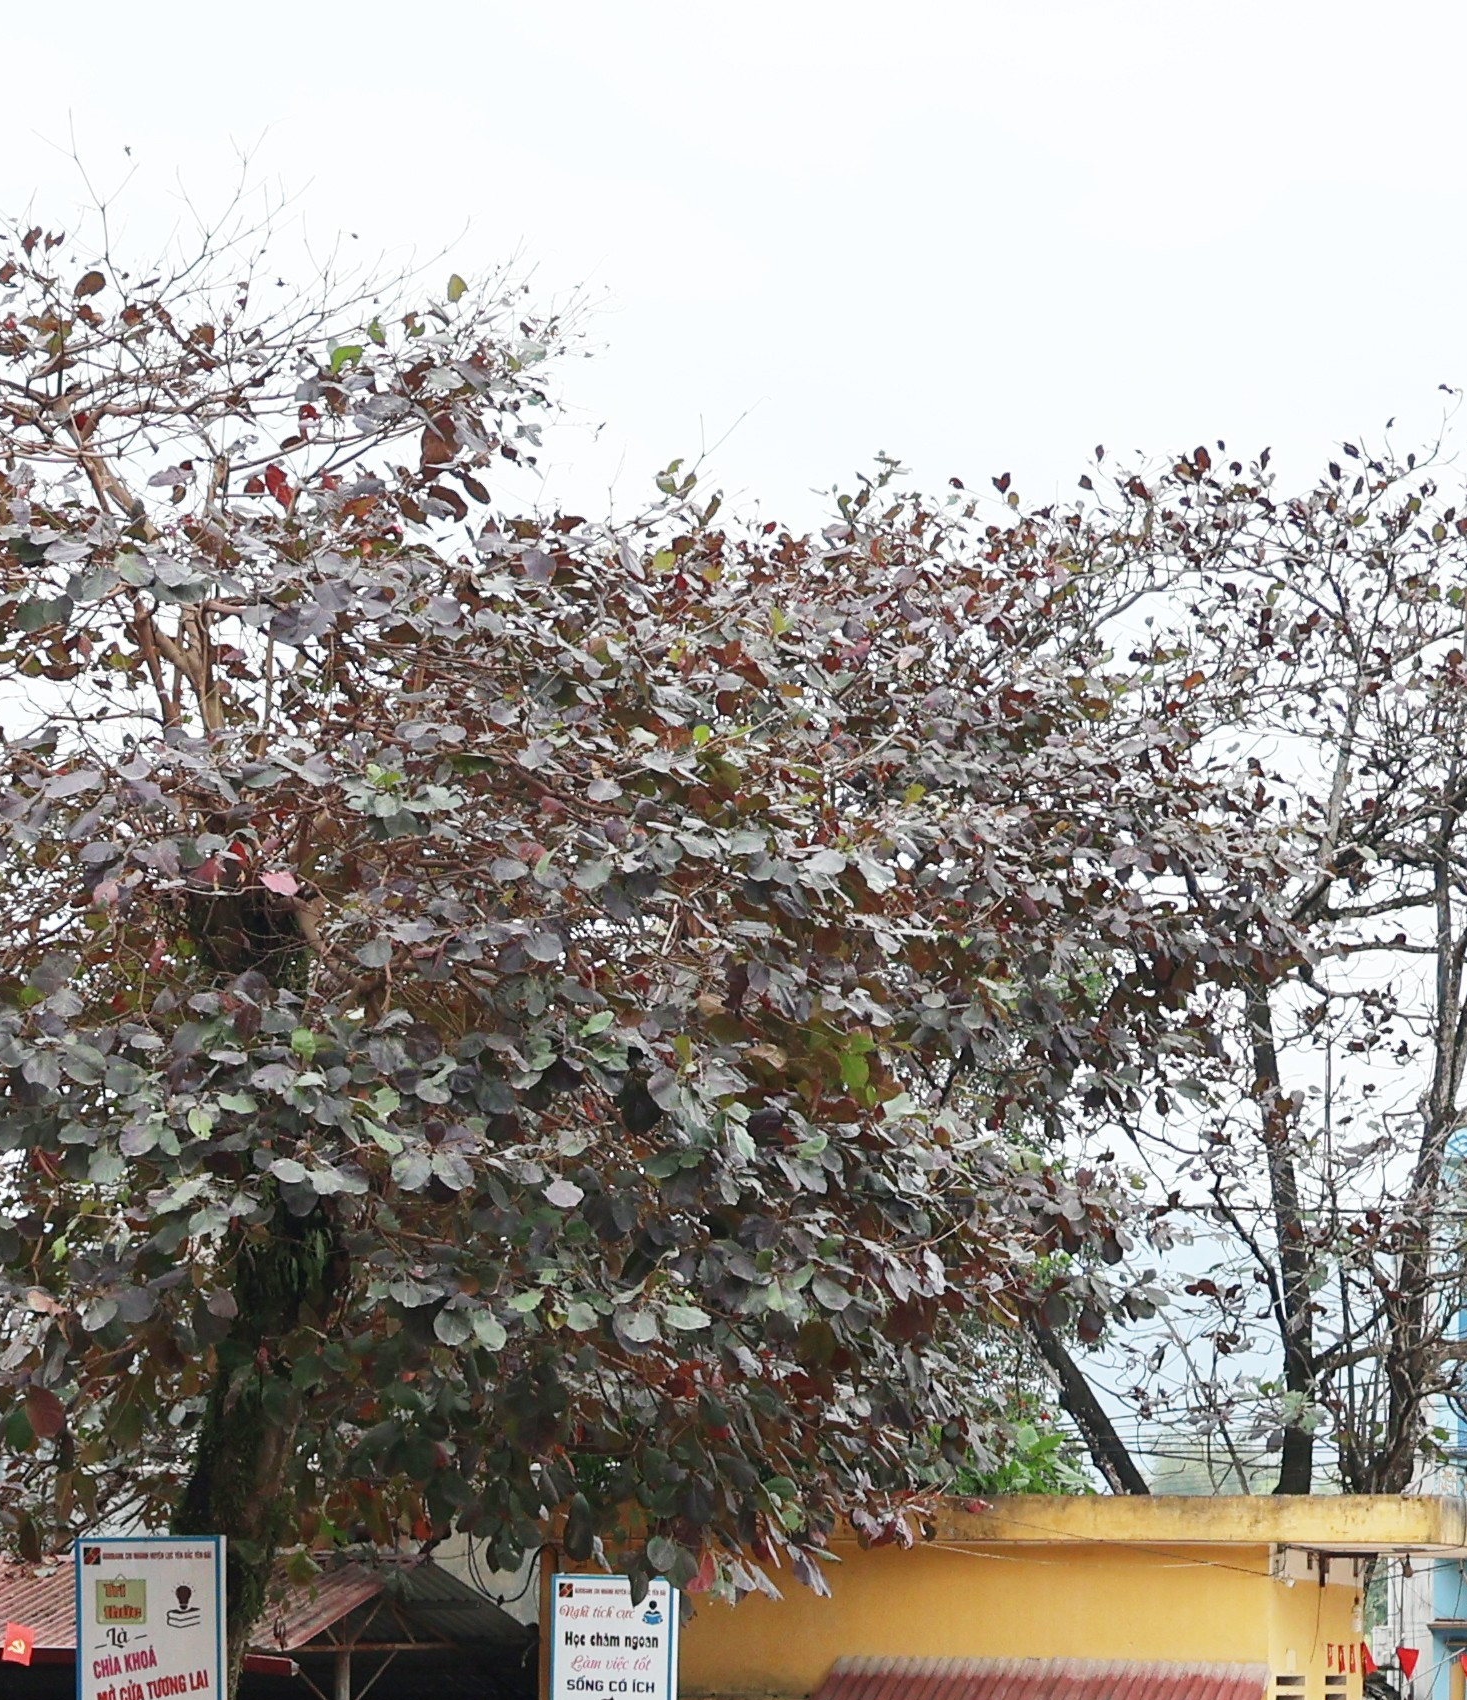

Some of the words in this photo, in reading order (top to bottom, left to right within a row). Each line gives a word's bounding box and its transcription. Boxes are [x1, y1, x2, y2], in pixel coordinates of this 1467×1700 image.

[106, 1627, 129, 1648] Là
[565, 1630, 585, 1648] Học
[624, 1635, 659, 1651] ngoan
[92, 1653, 122, 1680] CHÌA
[123, 1644, 157, 1673] KHOÁ
[570, 1654, 602, 1673] Làm
[605, 1656, 629, 1672] việc
[633, 1654, 652, 1671] tốt
[189, 1669, 209, 1691] LAI
[566, 1674, 604, 1692] SỐNG
[608, 1678, 628, 1693] CÓ
[632, 1678, 656, 1694] ÍCH
